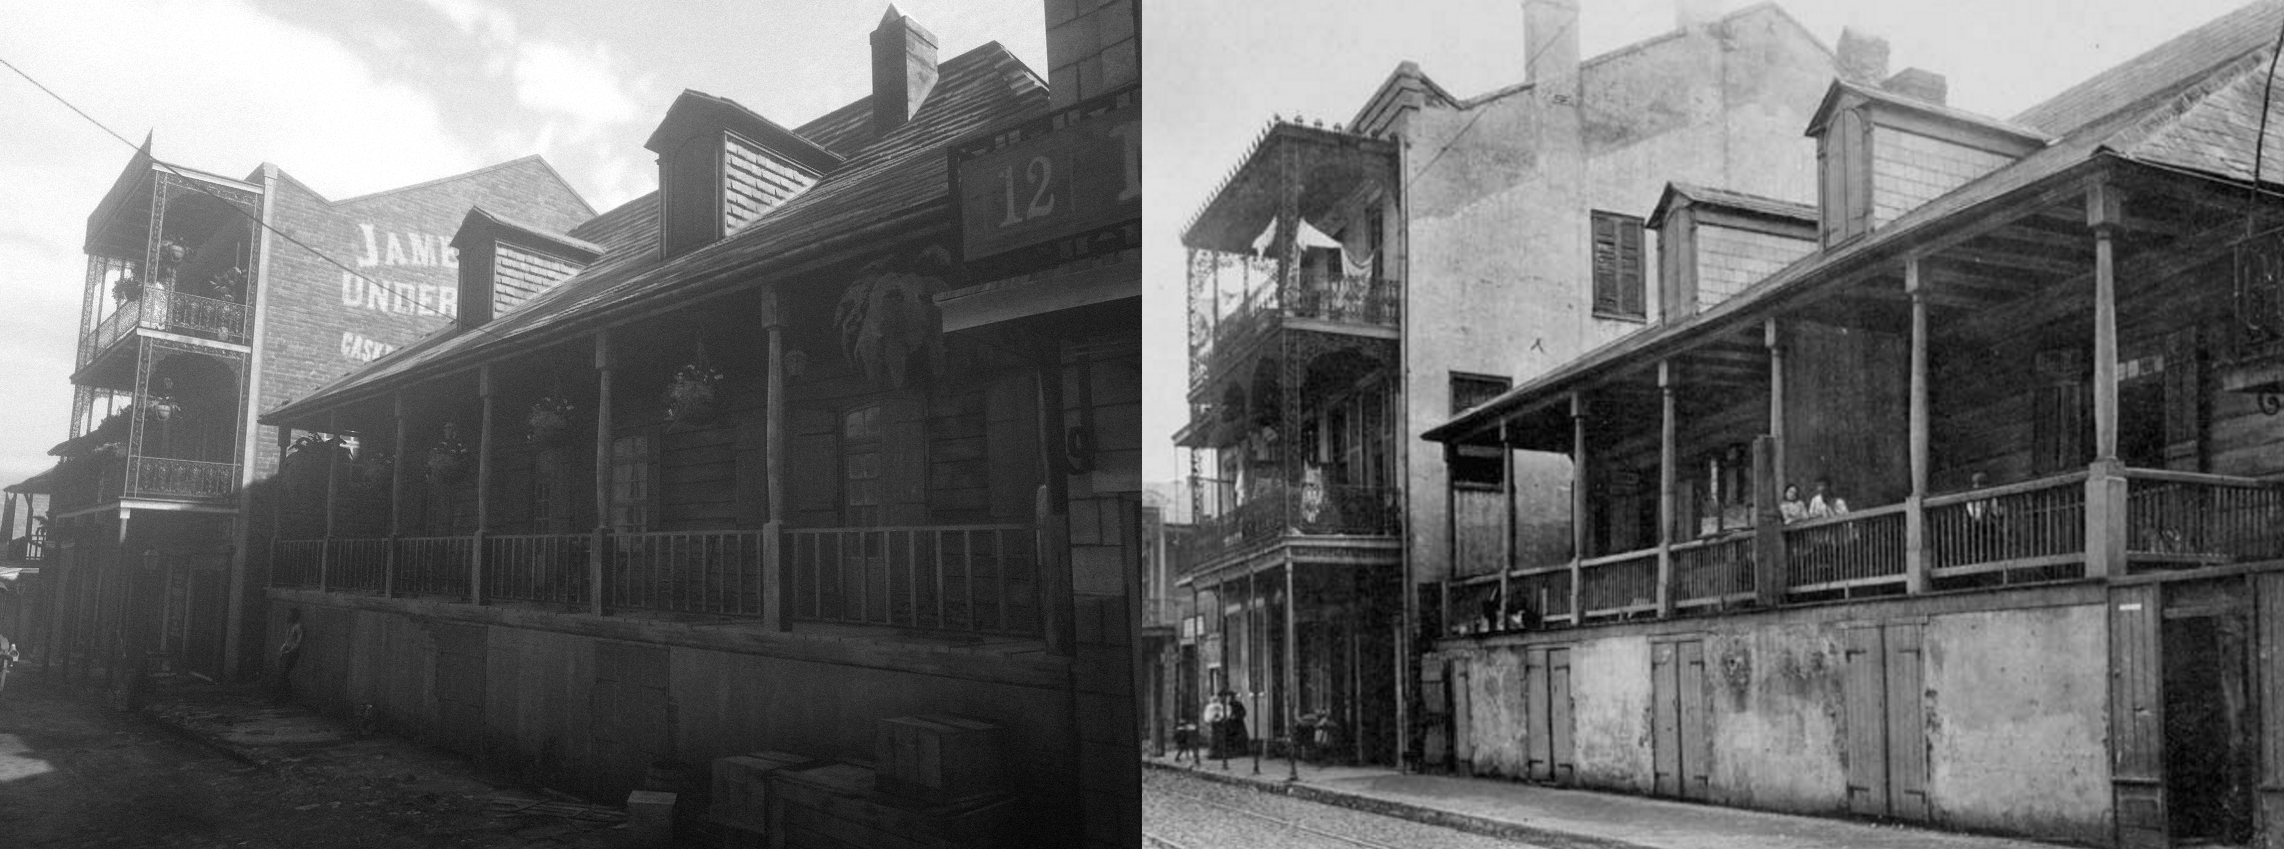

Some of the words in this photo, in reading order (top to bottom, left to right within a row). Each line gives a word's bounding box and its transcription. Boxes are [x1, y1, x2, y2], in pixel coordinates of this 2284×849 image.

[1000, 156, 1056, 228] 12
[342, 270, 459, 320] UNDER
[341, 331, 397, 363] CASK
